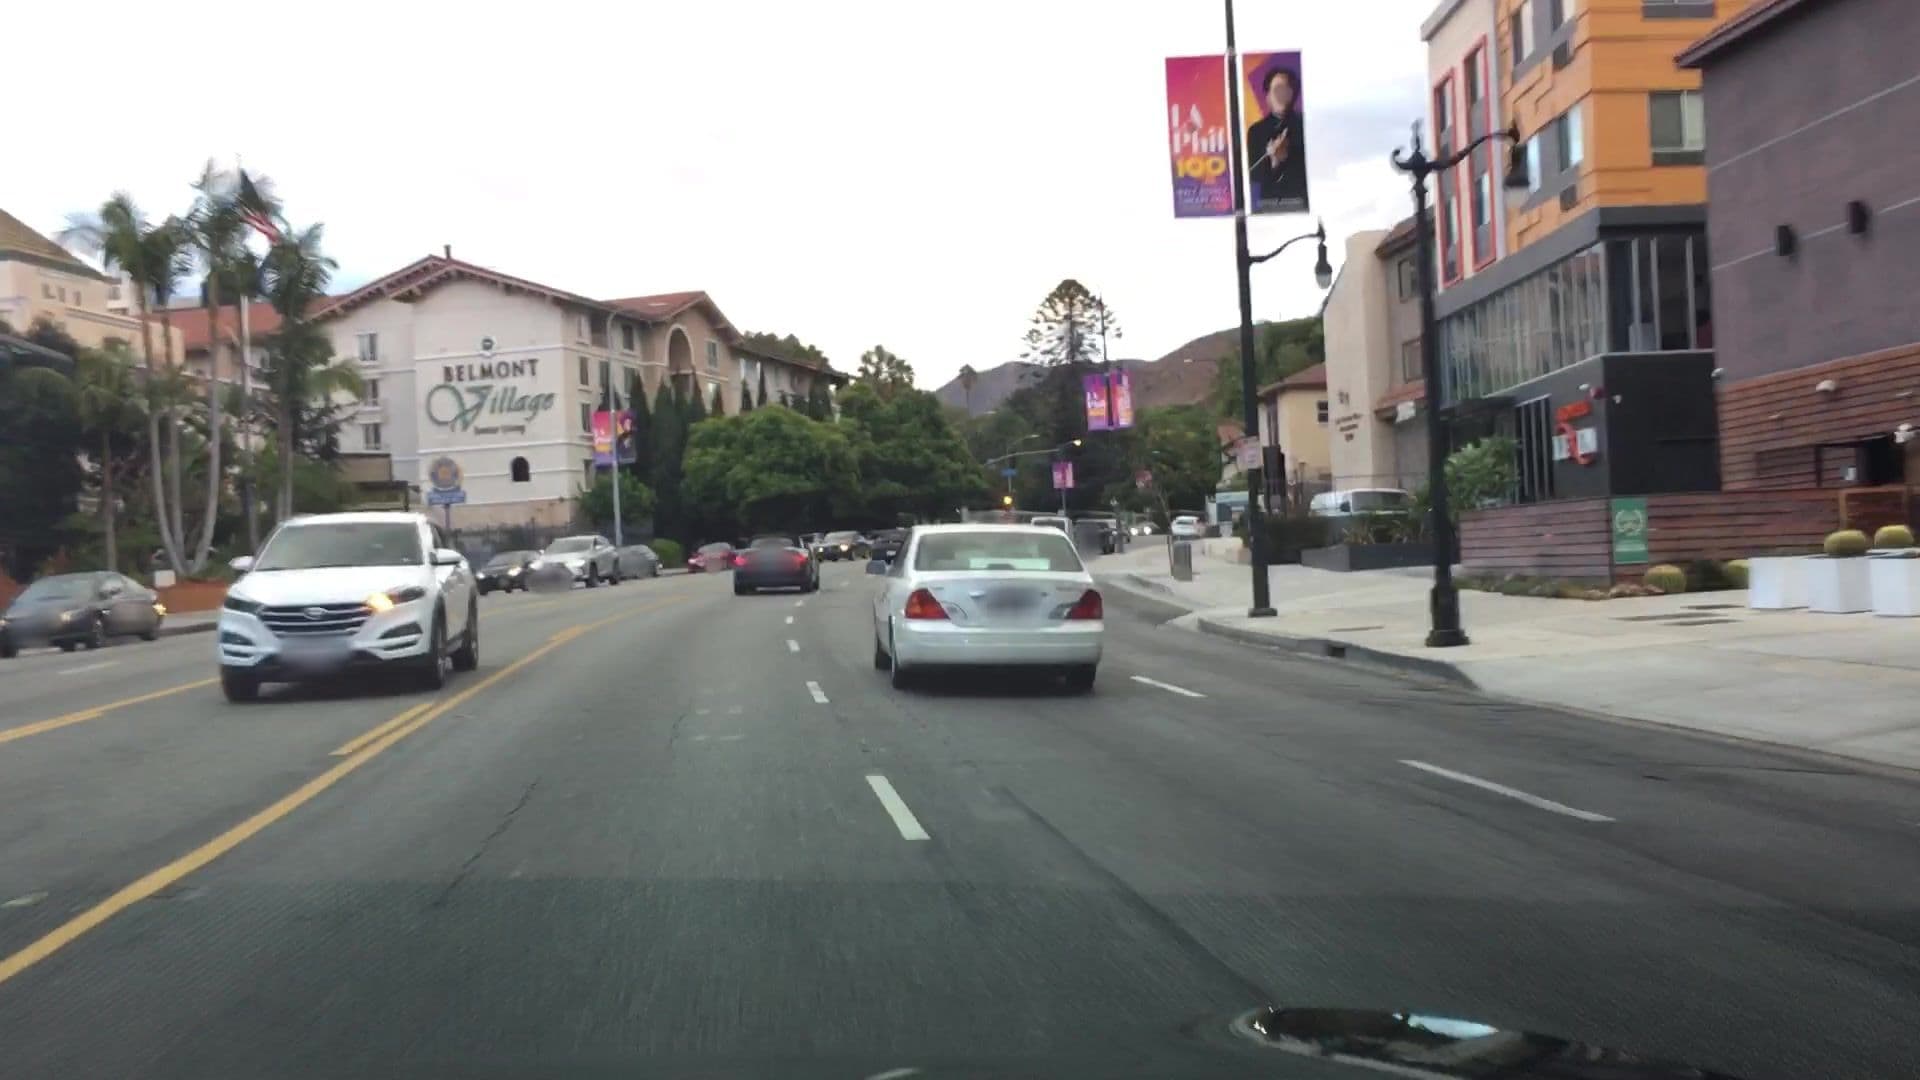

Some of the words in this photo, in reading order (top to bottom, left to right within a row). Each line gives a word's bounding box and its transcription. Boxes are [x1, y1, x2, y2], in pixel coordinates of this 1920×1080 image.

[1173, 126, 1225, 154] Phil
[1175, 155, 1227, 178] 100
[443, 359, 539, 383] BELMONT
[426, 384, 557, 433] Village
